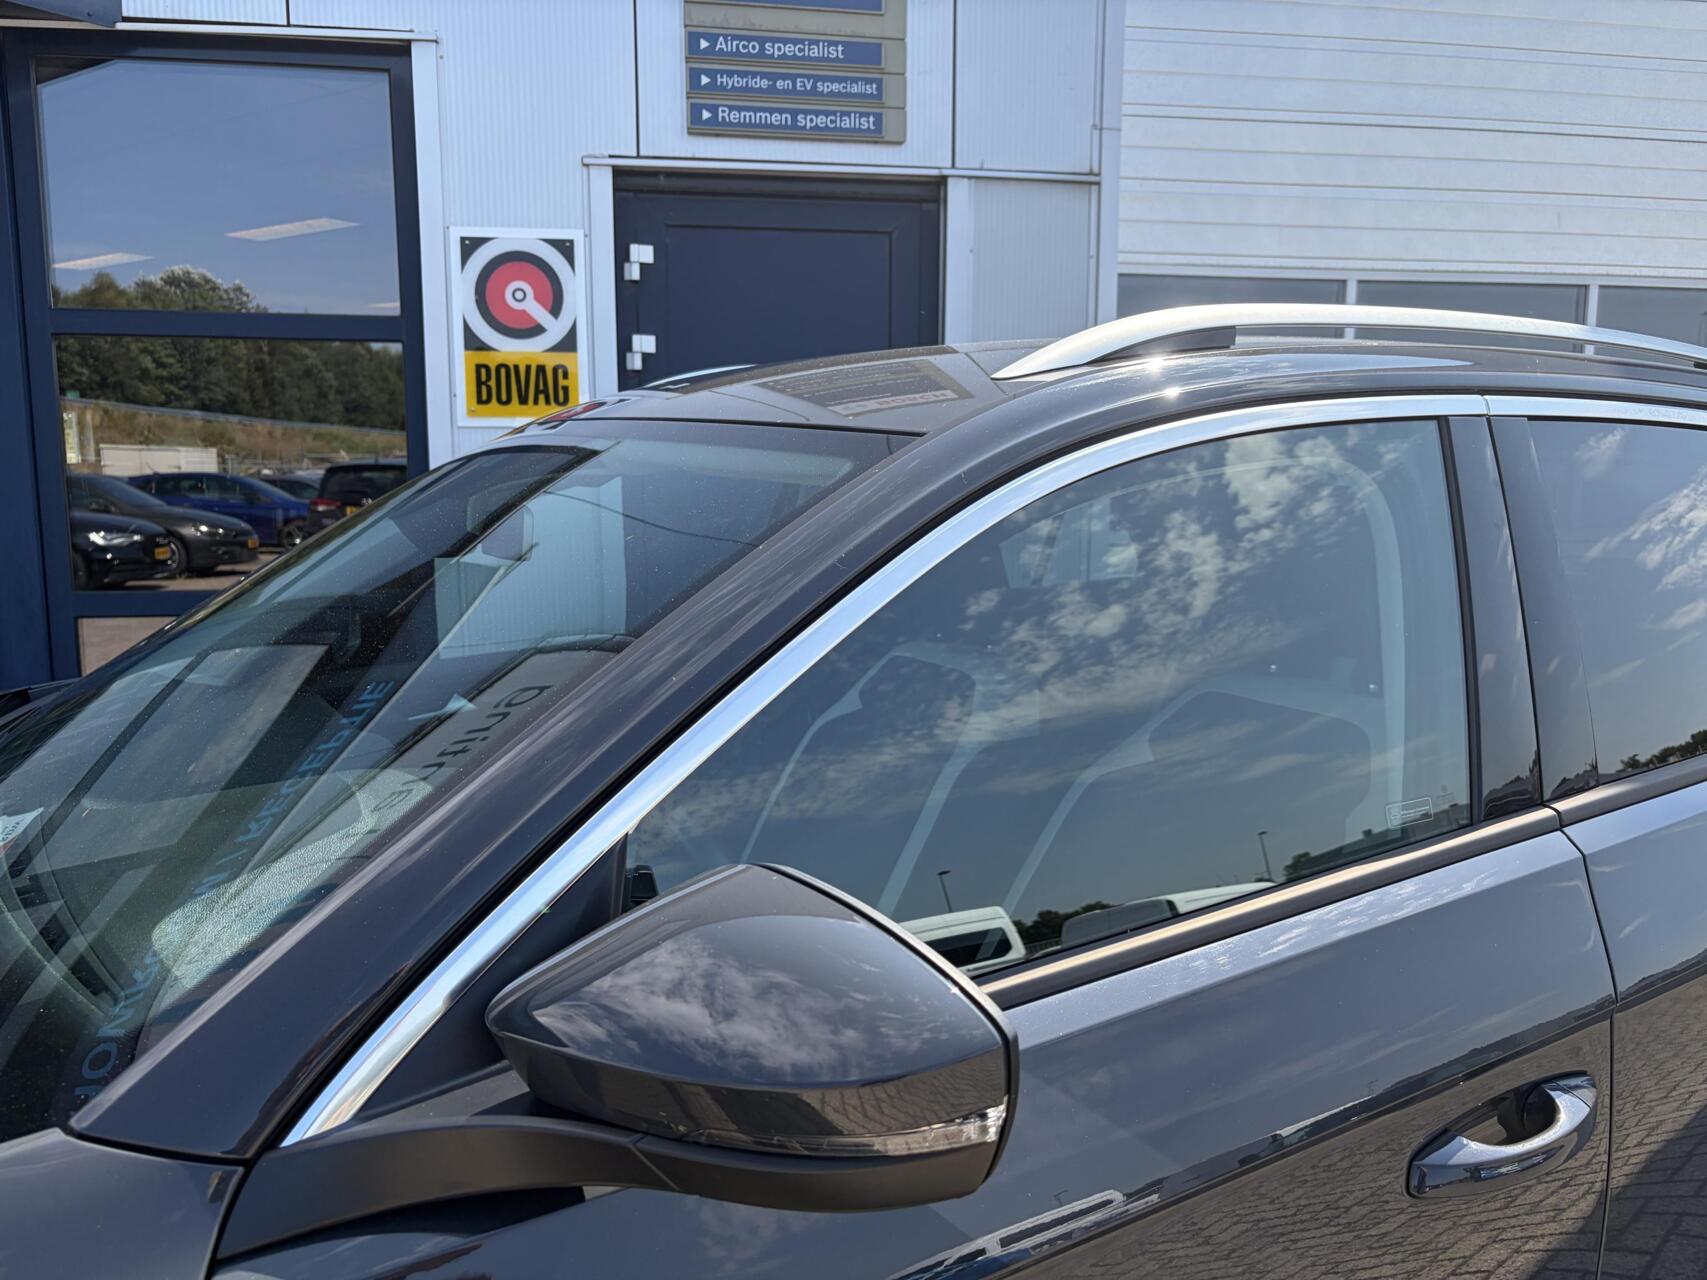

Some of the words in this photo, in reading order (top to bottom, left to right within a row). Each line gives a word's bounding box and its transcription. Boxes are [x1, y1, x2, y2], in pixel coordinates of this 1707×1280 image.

[715, 36, 760, 54] Airco
[764, 41, 844, 59] specialist
[716, 73, 773, 90] Hybride-
[776, 80, 792, 91] en
[796, 78, 814, 91] EV
[816, 80, 878, 95] specialist
[718, 107, 792, 126] Remmen
[796, 112, 876, 130] specialist
[474, 363, 571, 407] BOVAG
